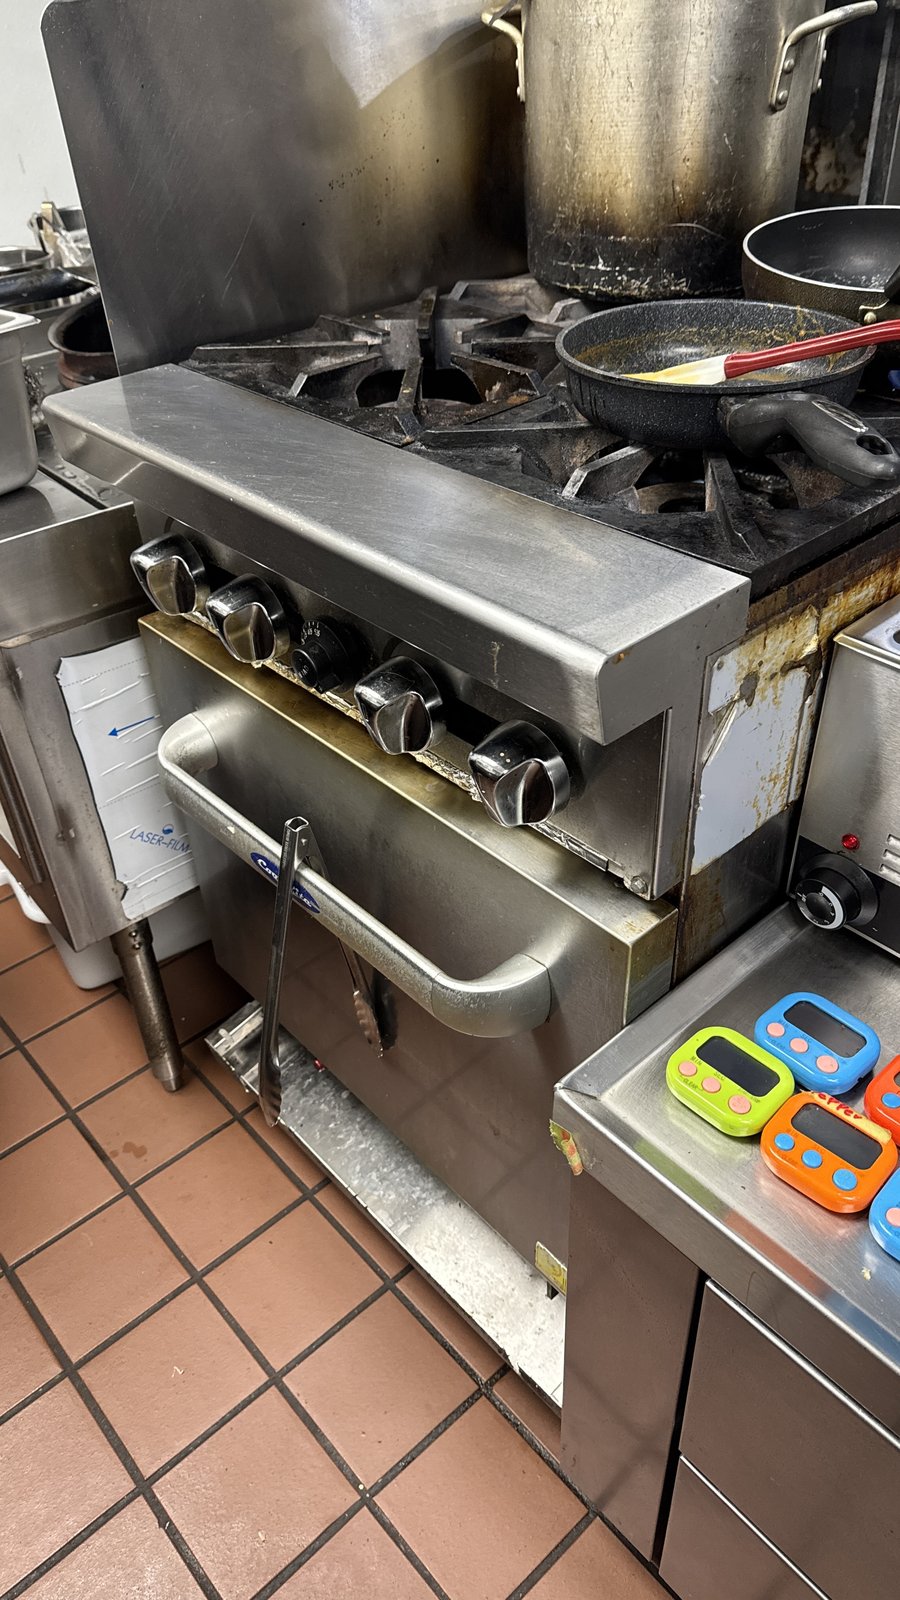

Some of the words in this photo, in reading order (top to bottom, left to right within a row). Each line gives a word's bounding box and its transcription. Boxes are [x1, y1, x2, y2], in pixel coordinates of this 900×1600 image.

[130, 829, 190, 853] LASER-FILM
[690, 1055, 703, 1066] MIN
[713, 1071, 726, 1082] SEC
